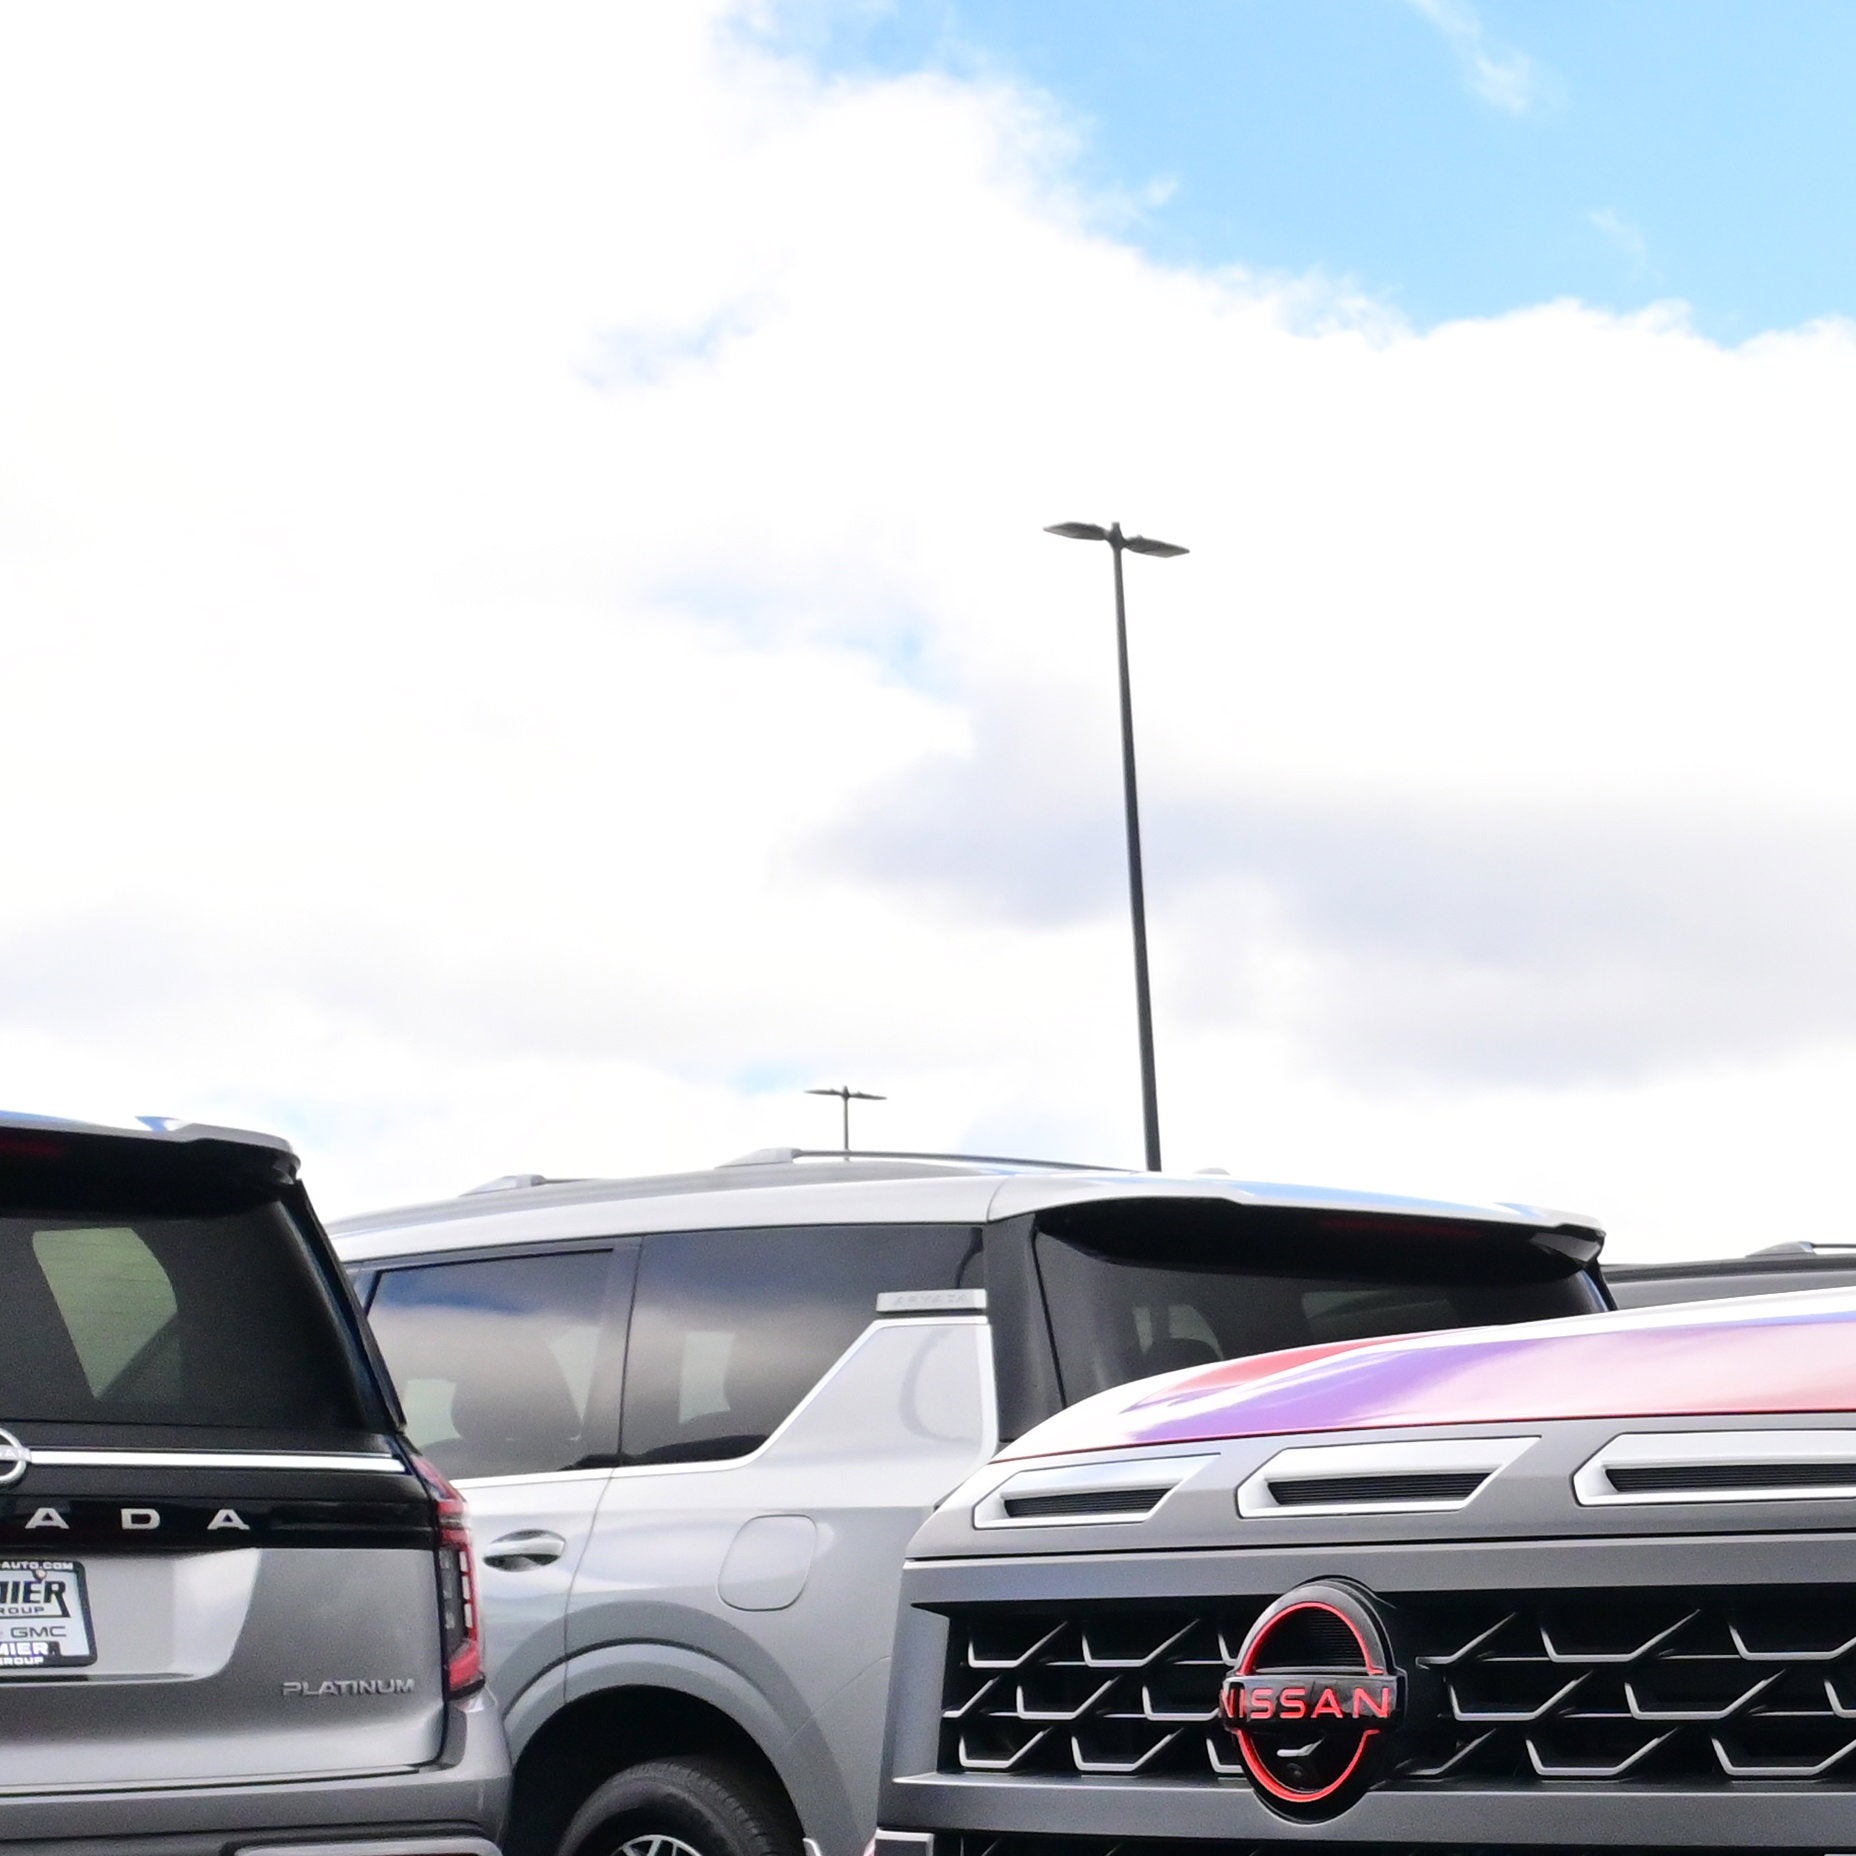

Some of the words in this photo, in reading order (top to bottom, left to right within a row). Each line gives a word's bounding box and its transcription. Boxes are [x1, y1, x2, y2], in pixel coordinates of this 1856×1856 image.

[25, 1508, 250, 1531] ADA
[1, 1561, 74, 1570] AUTO.COM
[10, 1626, 67, 1639] GMC
[283, 1678, 416, 1696] PLATINUM
[1220, 1687, 1390, 1720] NISSAN
